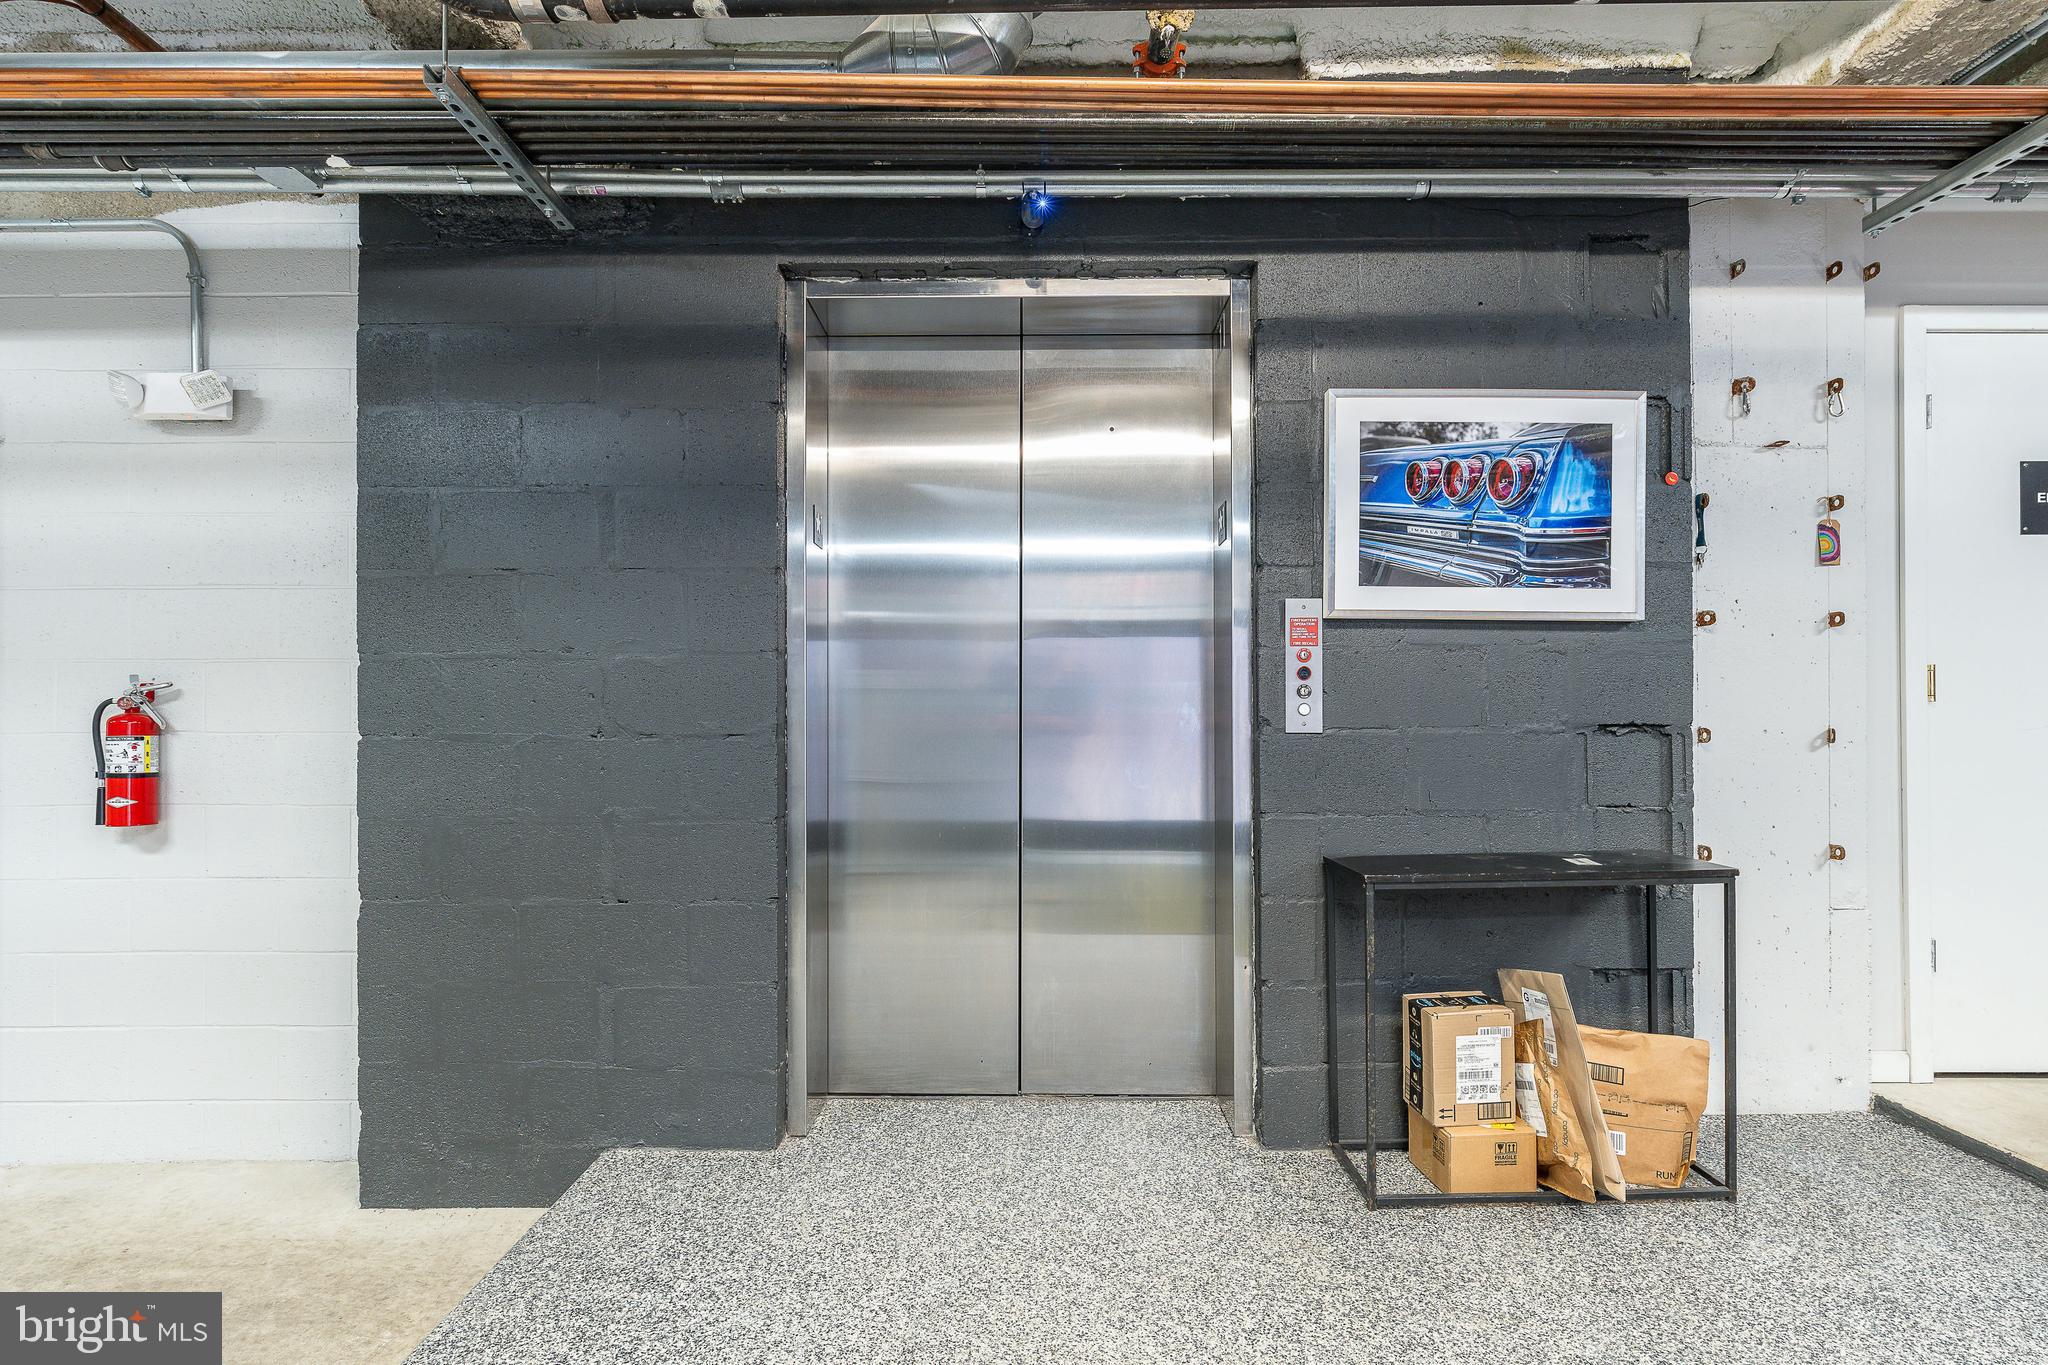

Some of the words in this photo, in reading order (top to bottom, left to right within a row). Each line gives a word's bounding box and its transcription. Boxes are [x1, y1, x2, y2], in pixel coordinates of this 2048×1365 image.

[2037, 492, 2048, 503] E
[1523, 992, 1530, 1002] G
[1551, 1089, 1559, 1116] canopy
